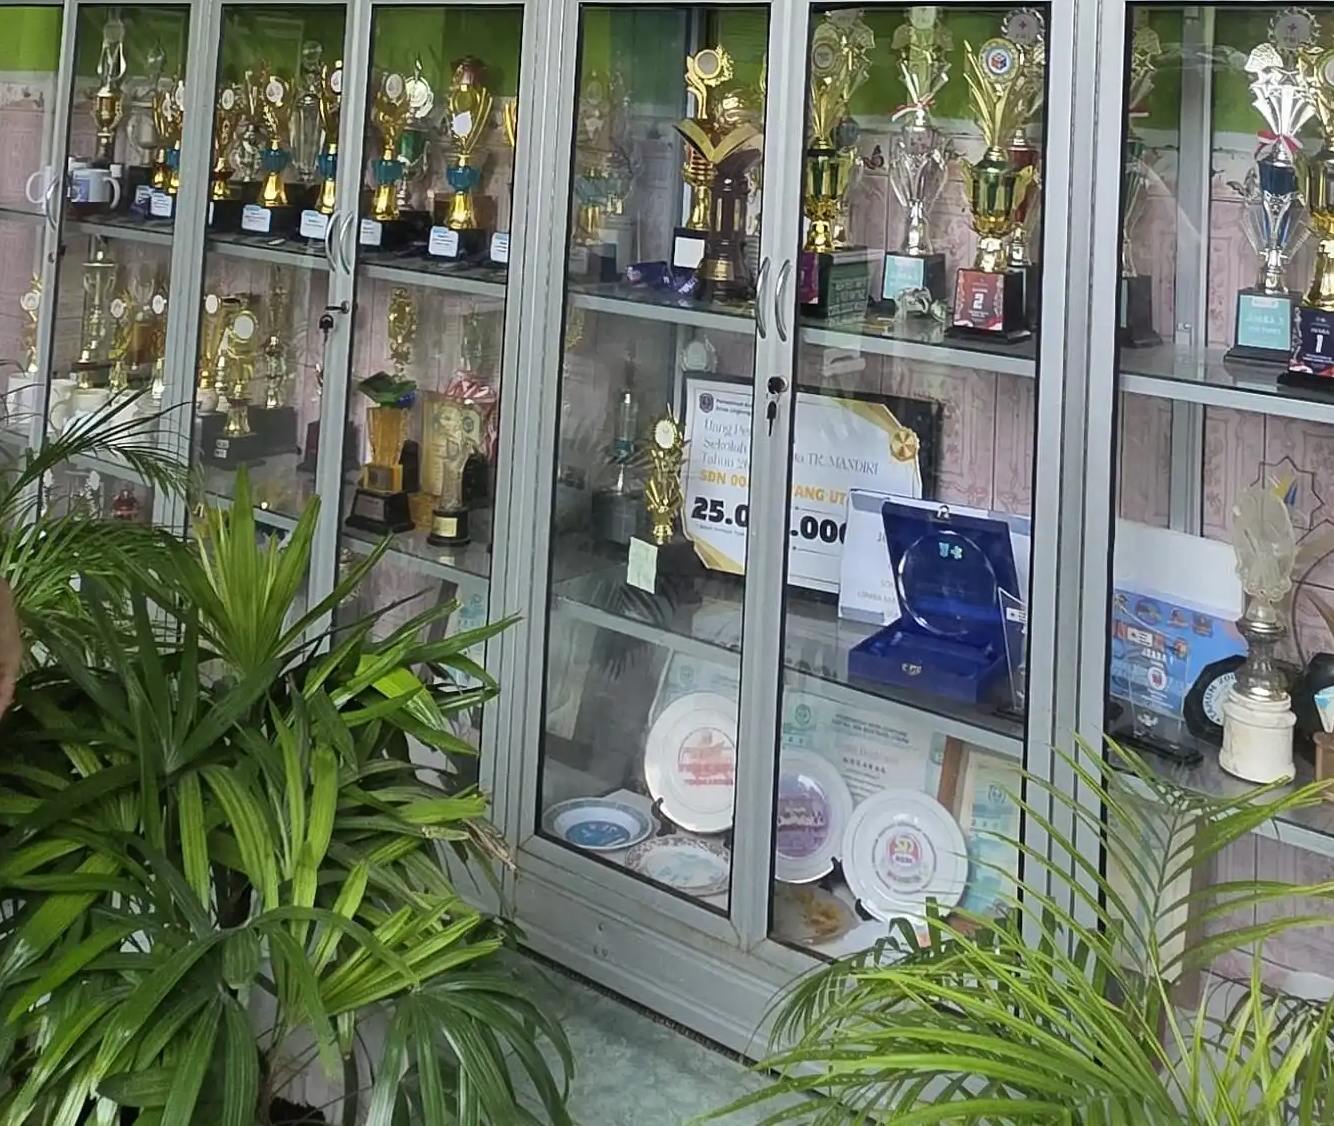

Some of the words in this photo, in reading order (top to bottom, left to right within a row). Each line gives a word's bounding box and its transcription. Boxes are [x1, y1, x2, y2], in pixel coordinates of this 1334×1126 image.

[973, 293, 984, 310] 2
[1315, 334, 1324, 353] 1
[828, 455, 879, 475] MANDIRI
[700, 470, 727, 485] SDN
[730, 473, 748, 488] 00
